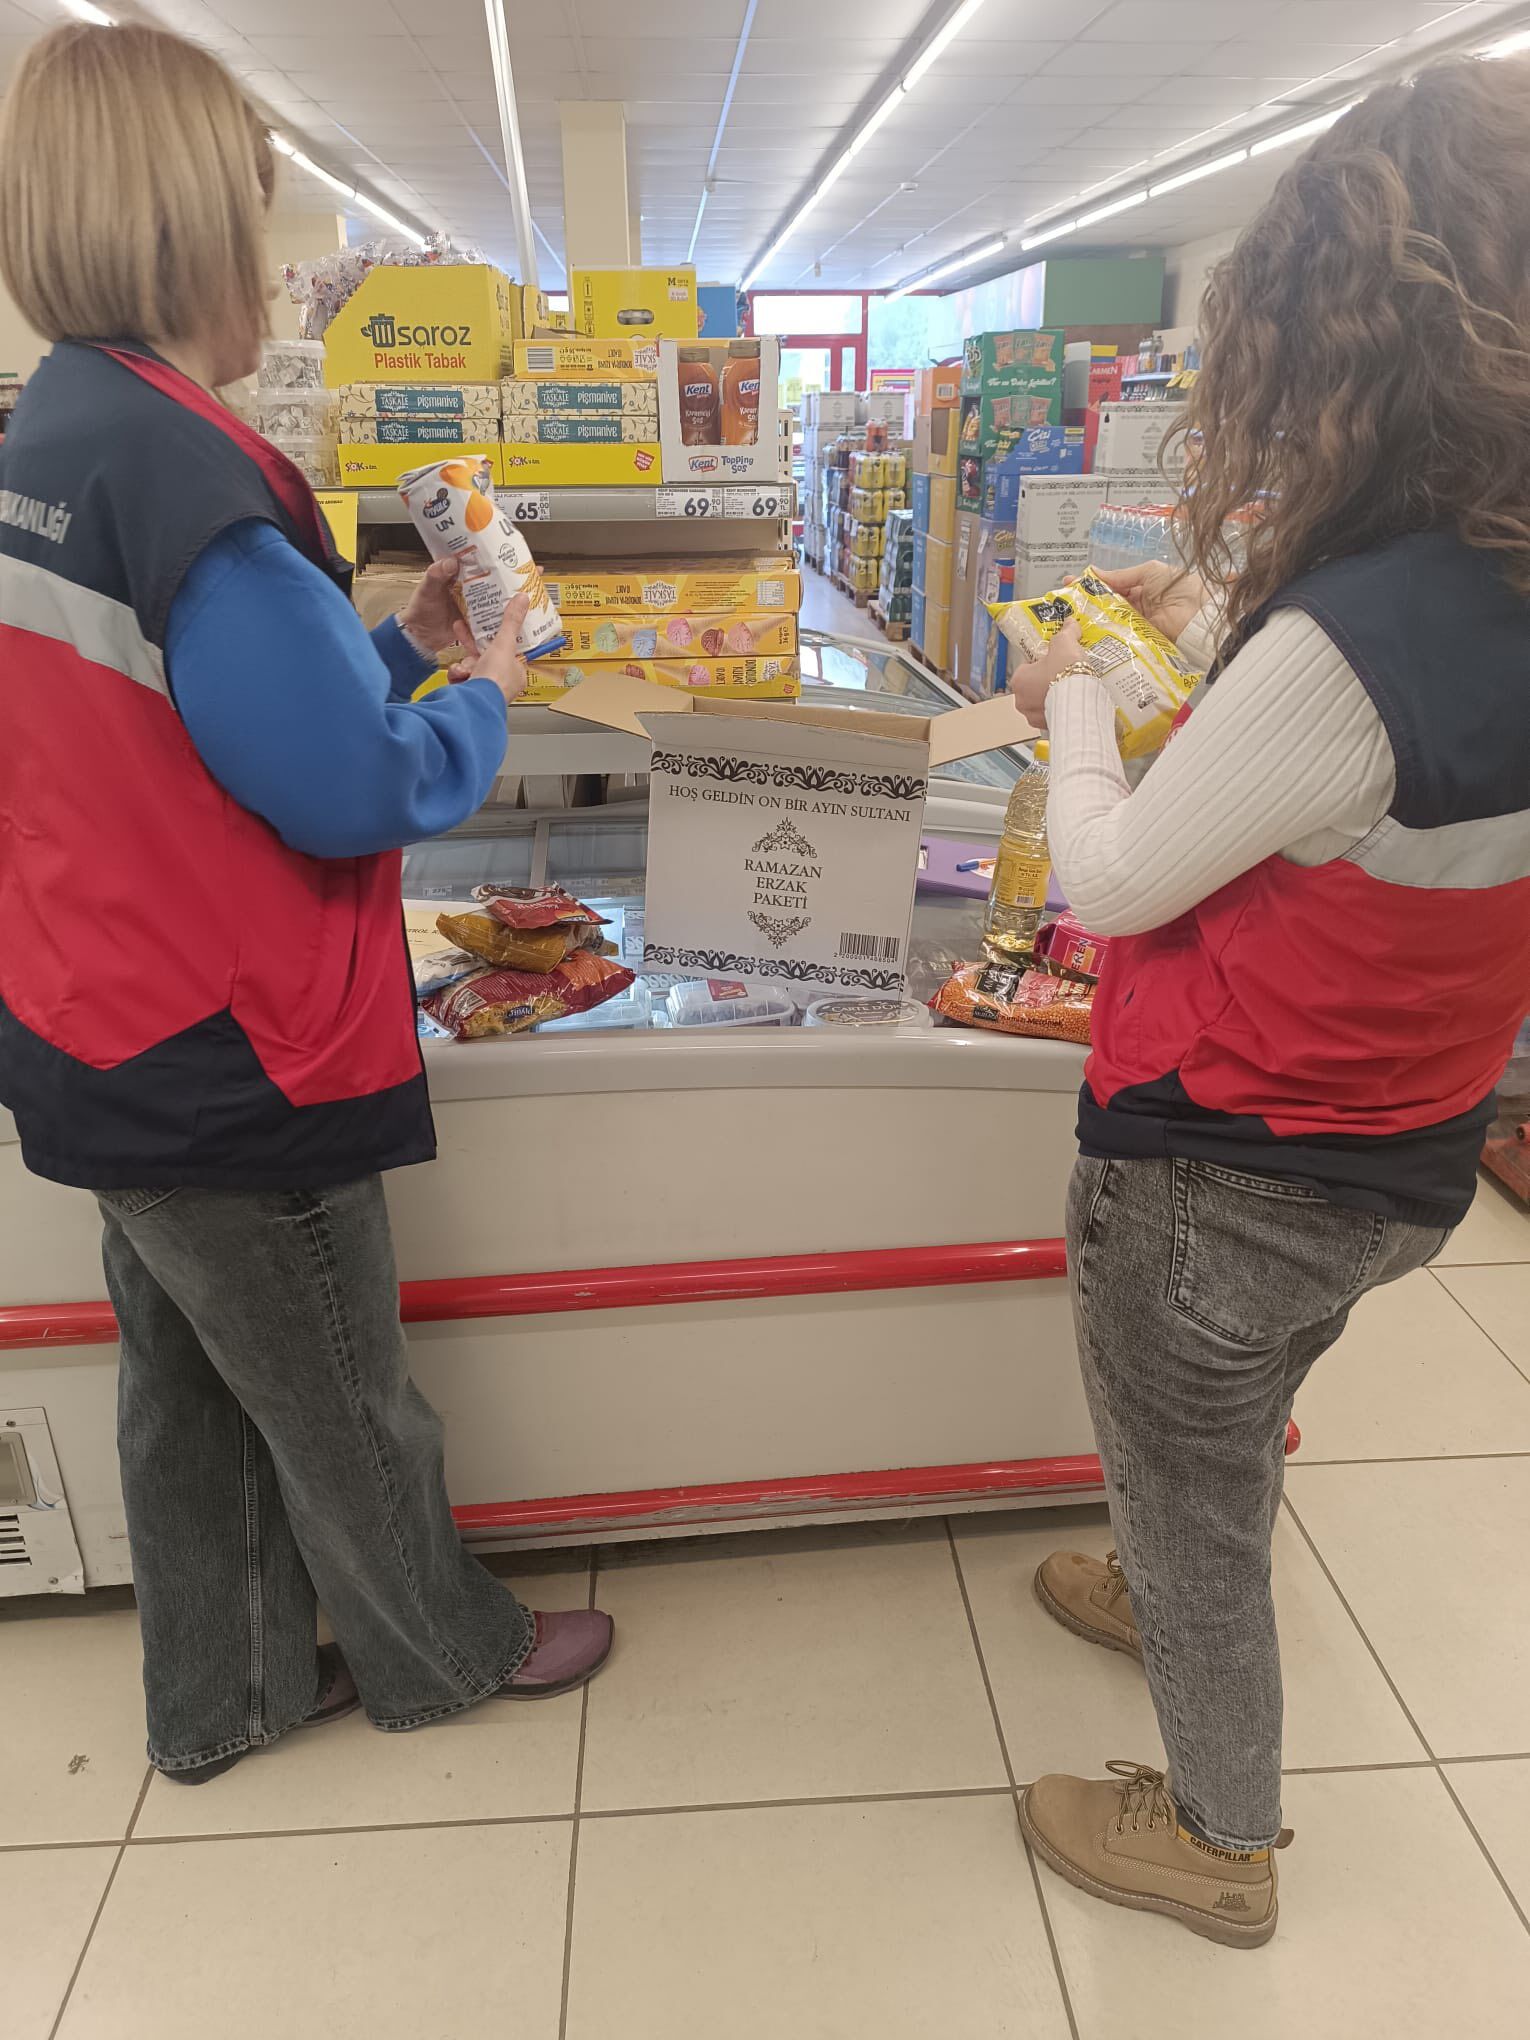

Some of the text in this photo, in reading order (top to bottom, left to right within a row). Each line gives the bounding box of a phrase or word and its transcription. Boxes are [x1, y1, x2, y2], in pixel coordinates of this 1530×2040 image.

[397, 325, 472, 346] saroz
[374, 353, 467, 370] Plastik Tabak
[686, 385, 710, 396] Kent
[690, 459, 715, 469] Kent
[721, 456, 754, 466] Topping
[732, 465, 748, 474] Sos
[435, 516, 455, 532] UN
[669, 785, 912, 822] HOŞ GELDİN ON BİR AYIN SULTANI
[744, 859, 823, 879] RAMAZAN
[756, 877, 808, 894] ERZAK
[753, 893, 808, 909] PAKETİ
[1190, 1836, 1251, 1862] CATERPILLAR
